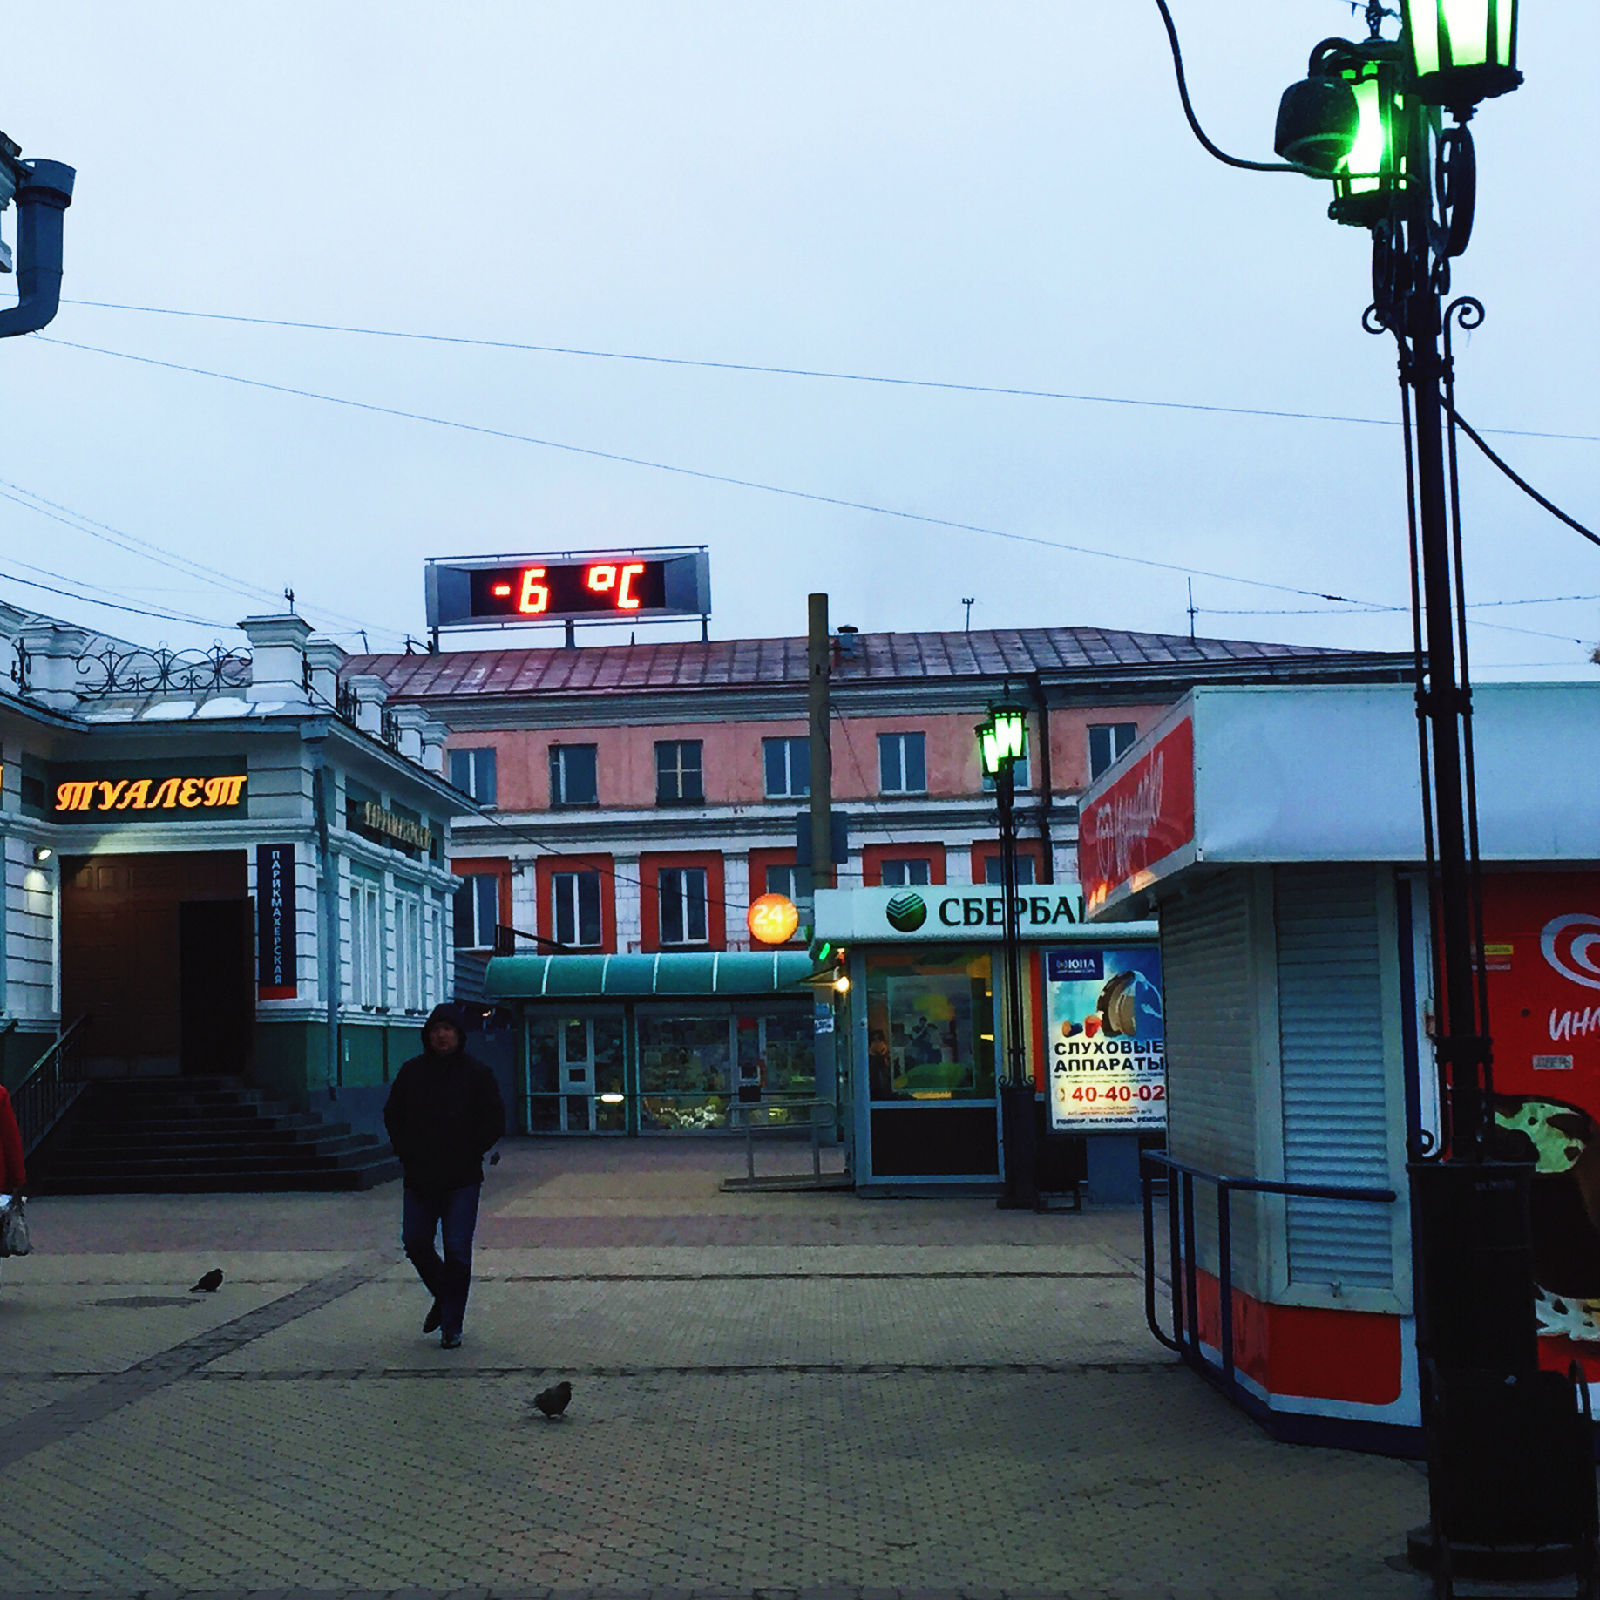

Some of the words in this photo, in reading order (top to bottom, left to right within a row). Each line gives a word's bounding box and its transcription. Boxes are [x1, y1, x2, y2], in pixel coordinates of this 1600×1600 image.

[493, 567, 549, 614] -6
[55, 776, 248, 811] ТУАЛЕТ
[271, 850, 283, 985] ПАРИКМАХЕРСКАЯ
[754, 904, 783, 925] 24
[938, 896, 1085, 926] СБЕРБА
[1054, 1040, 1164, 1056] СЛУХОВЫЕ
[1054, 1057, 1164, 1073] АППАРАТЫ
[1071, 1084, 1165, 1103] 40-40-02
